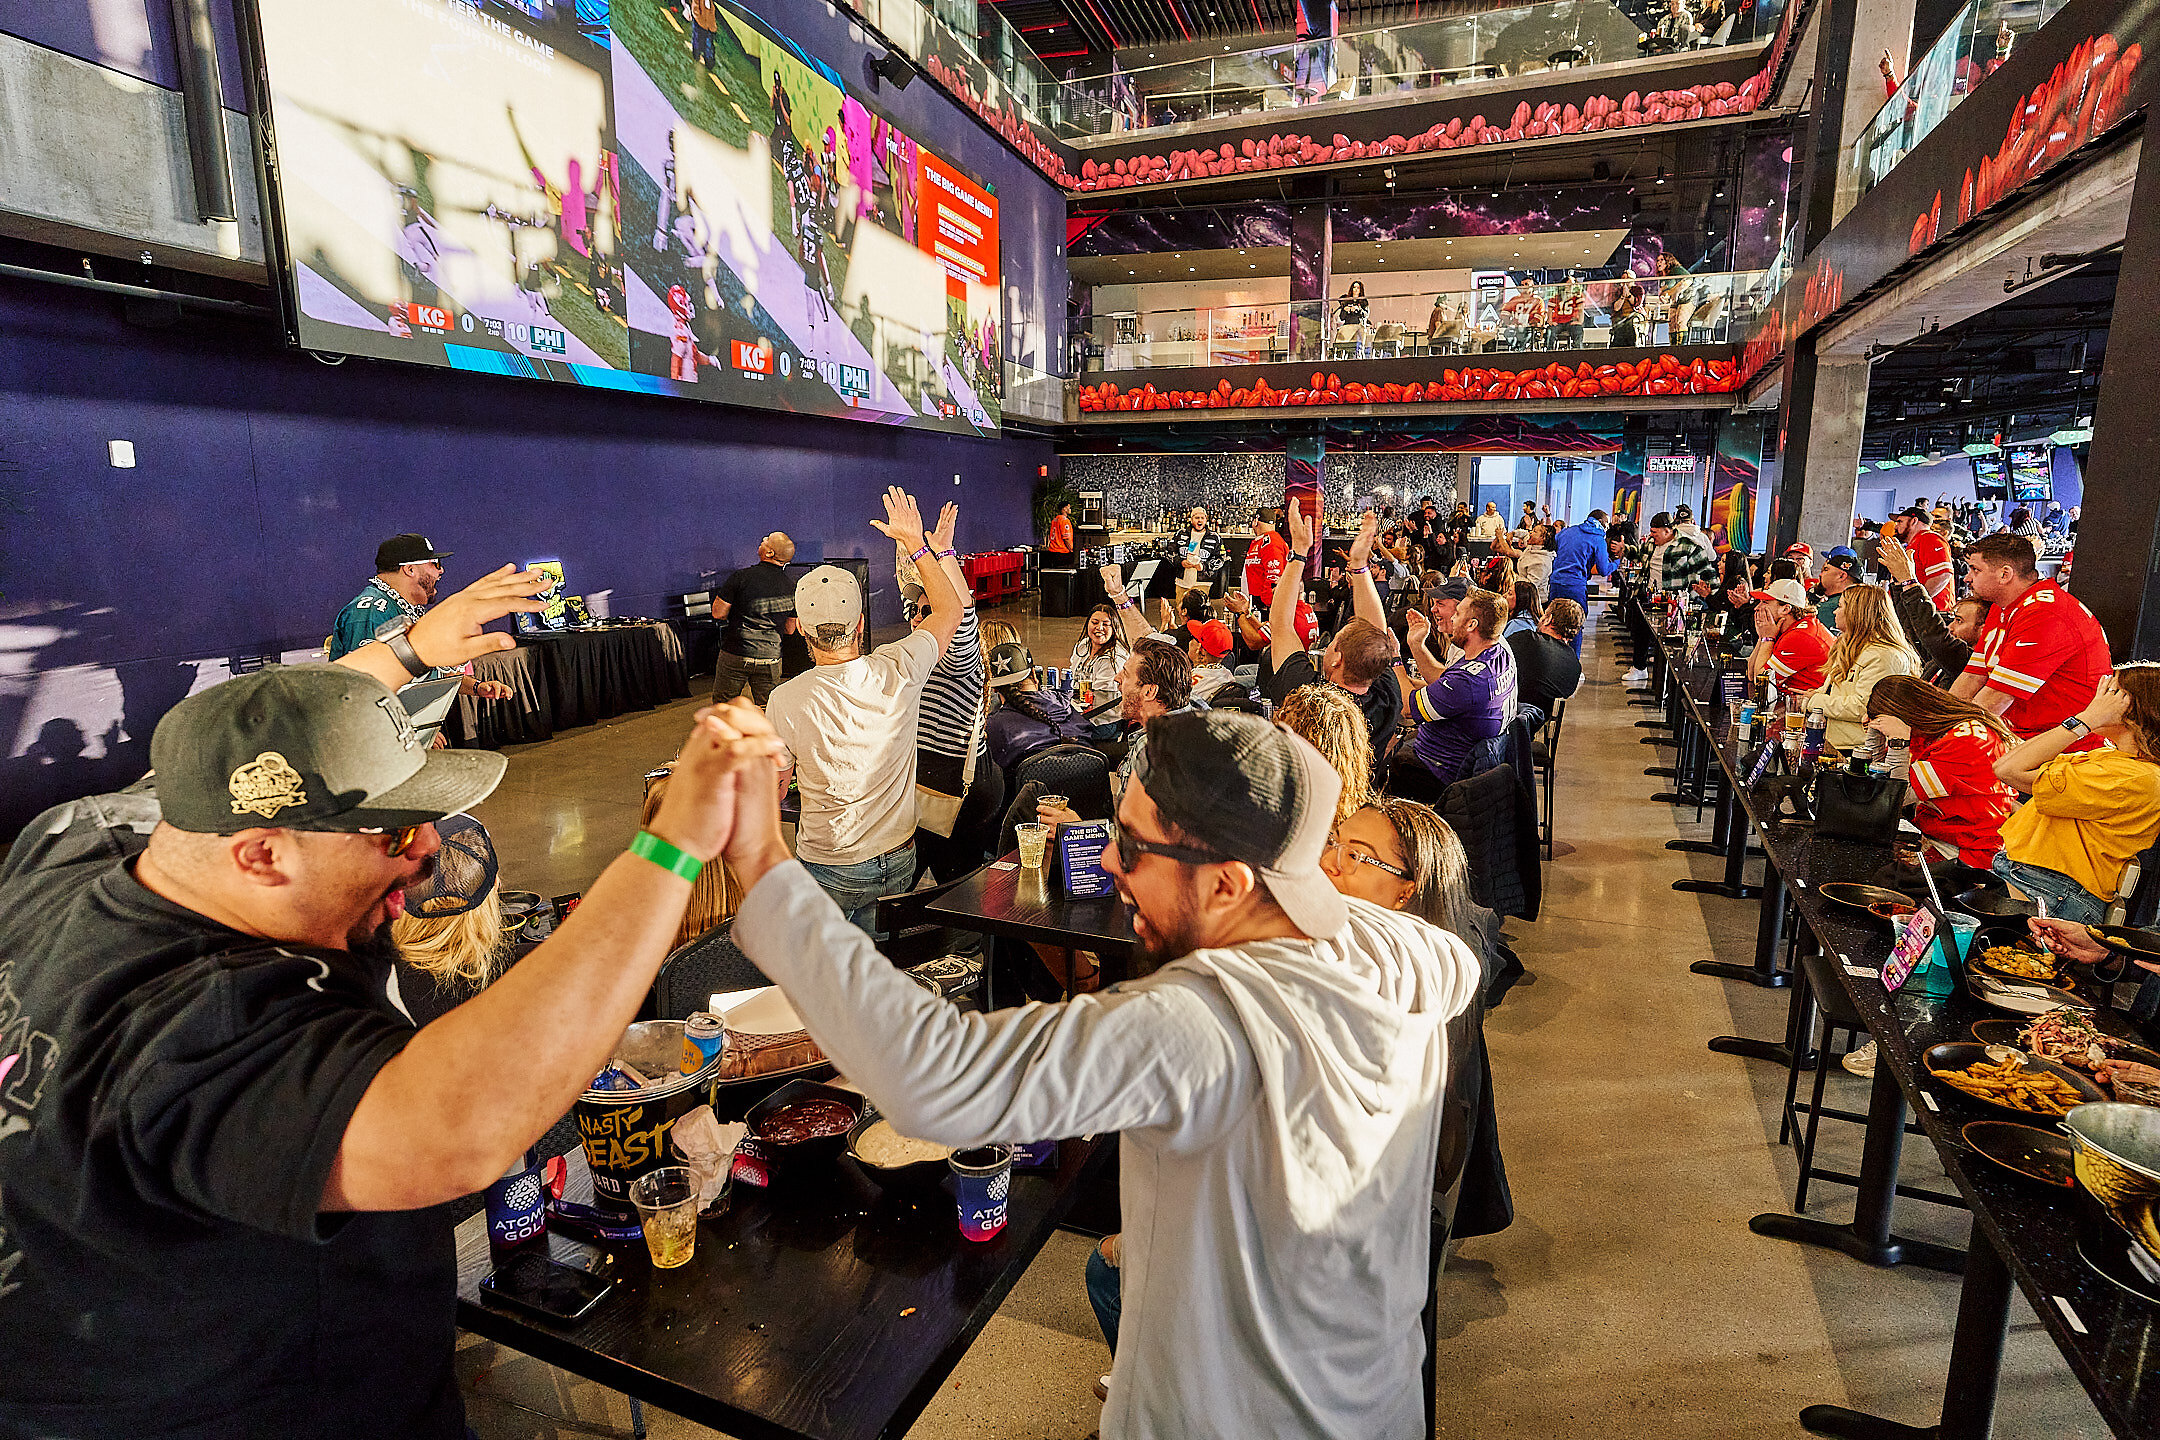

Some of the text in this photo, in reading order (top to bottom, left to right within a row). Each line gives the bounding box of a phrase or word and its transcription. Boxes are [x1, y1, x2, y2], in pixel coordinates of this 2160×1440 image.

[447, 0, 555, 60] TER THE GAME
[925, 165, 993, 219] THE BIG GAME MENU
[1479, 277, 1504, 286] UNDER
[417, 306, 562, 348] KC 0 7:03 10 PHI
[487, 328, 500, 337] 2ND
[740, 343, 867, 390] KC 0 7:03 10 PHI
[356, 596, 388, 613] 24
[1953, 719, 1988, 741] 32
[578, 1105, 644, 1138] NASTY
[495, 1203, 546, 1231] ATOMI
[981, 1212, 1008, 1231] GOL
